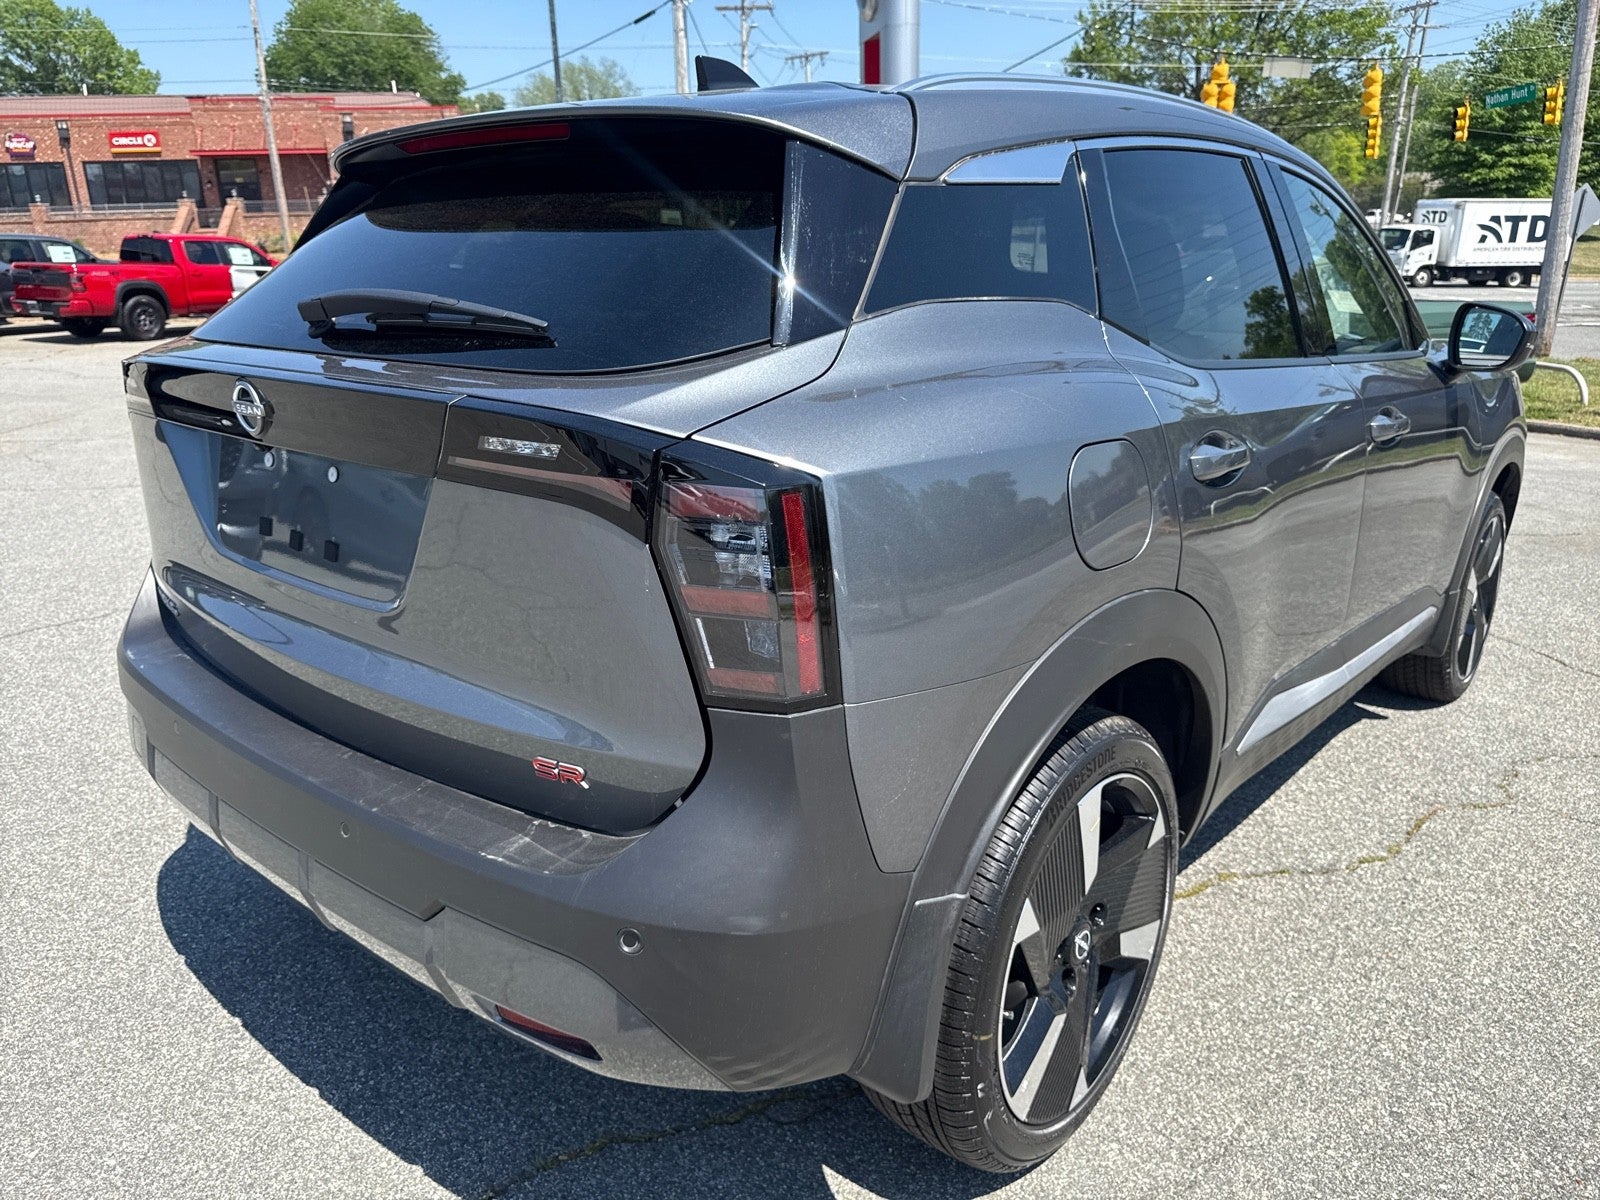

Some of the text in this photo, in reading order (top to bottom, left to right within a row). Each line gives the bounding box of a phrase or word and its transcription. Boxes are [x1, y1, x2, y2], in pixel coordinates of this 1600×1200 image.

[1485, 93, 1509, 106] Nathan
[1511, 86, 1528, 100] Hunt
[111, 136, 144, 146] CIRCLE
[1421, 210, 1448, 224] ATD
[1475, 215, 1551, 244] ATD
[533, 756, 589, 789] SR
[1046, 745, 1116, 831] BRIDGESTONE
